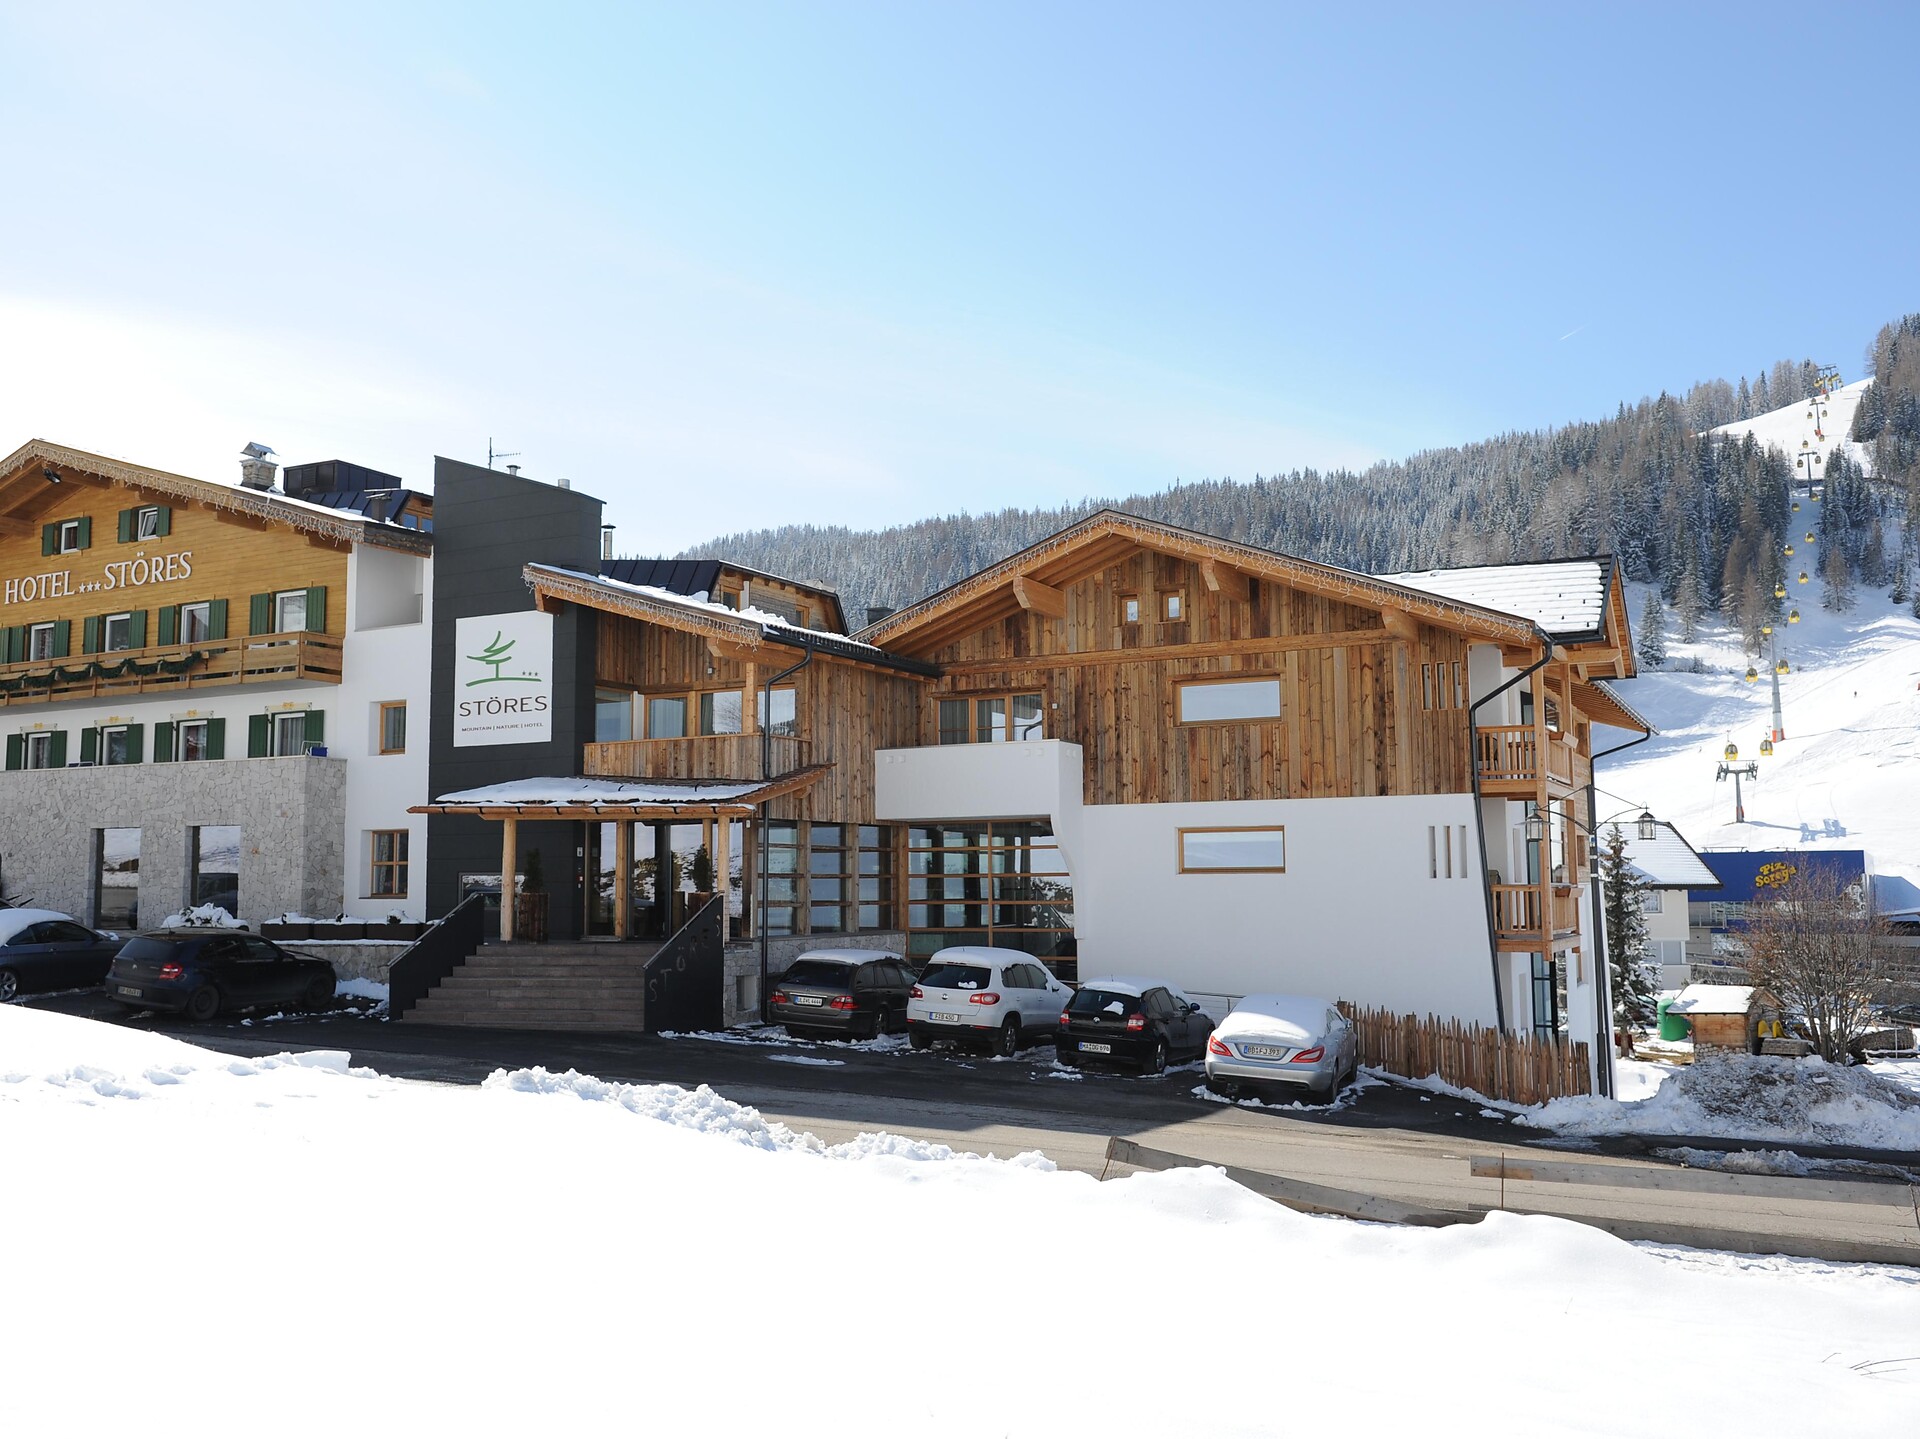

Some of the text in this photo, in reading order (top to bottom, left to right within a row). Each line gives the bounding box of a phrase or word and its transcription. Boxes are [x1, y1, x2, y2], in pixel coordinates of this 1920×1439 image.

[4, 550, 193, 605] HOTEL STÖRES
[459, 695, 548, 717] STÖRES
[1759, 862, 1787, 875] Piz
